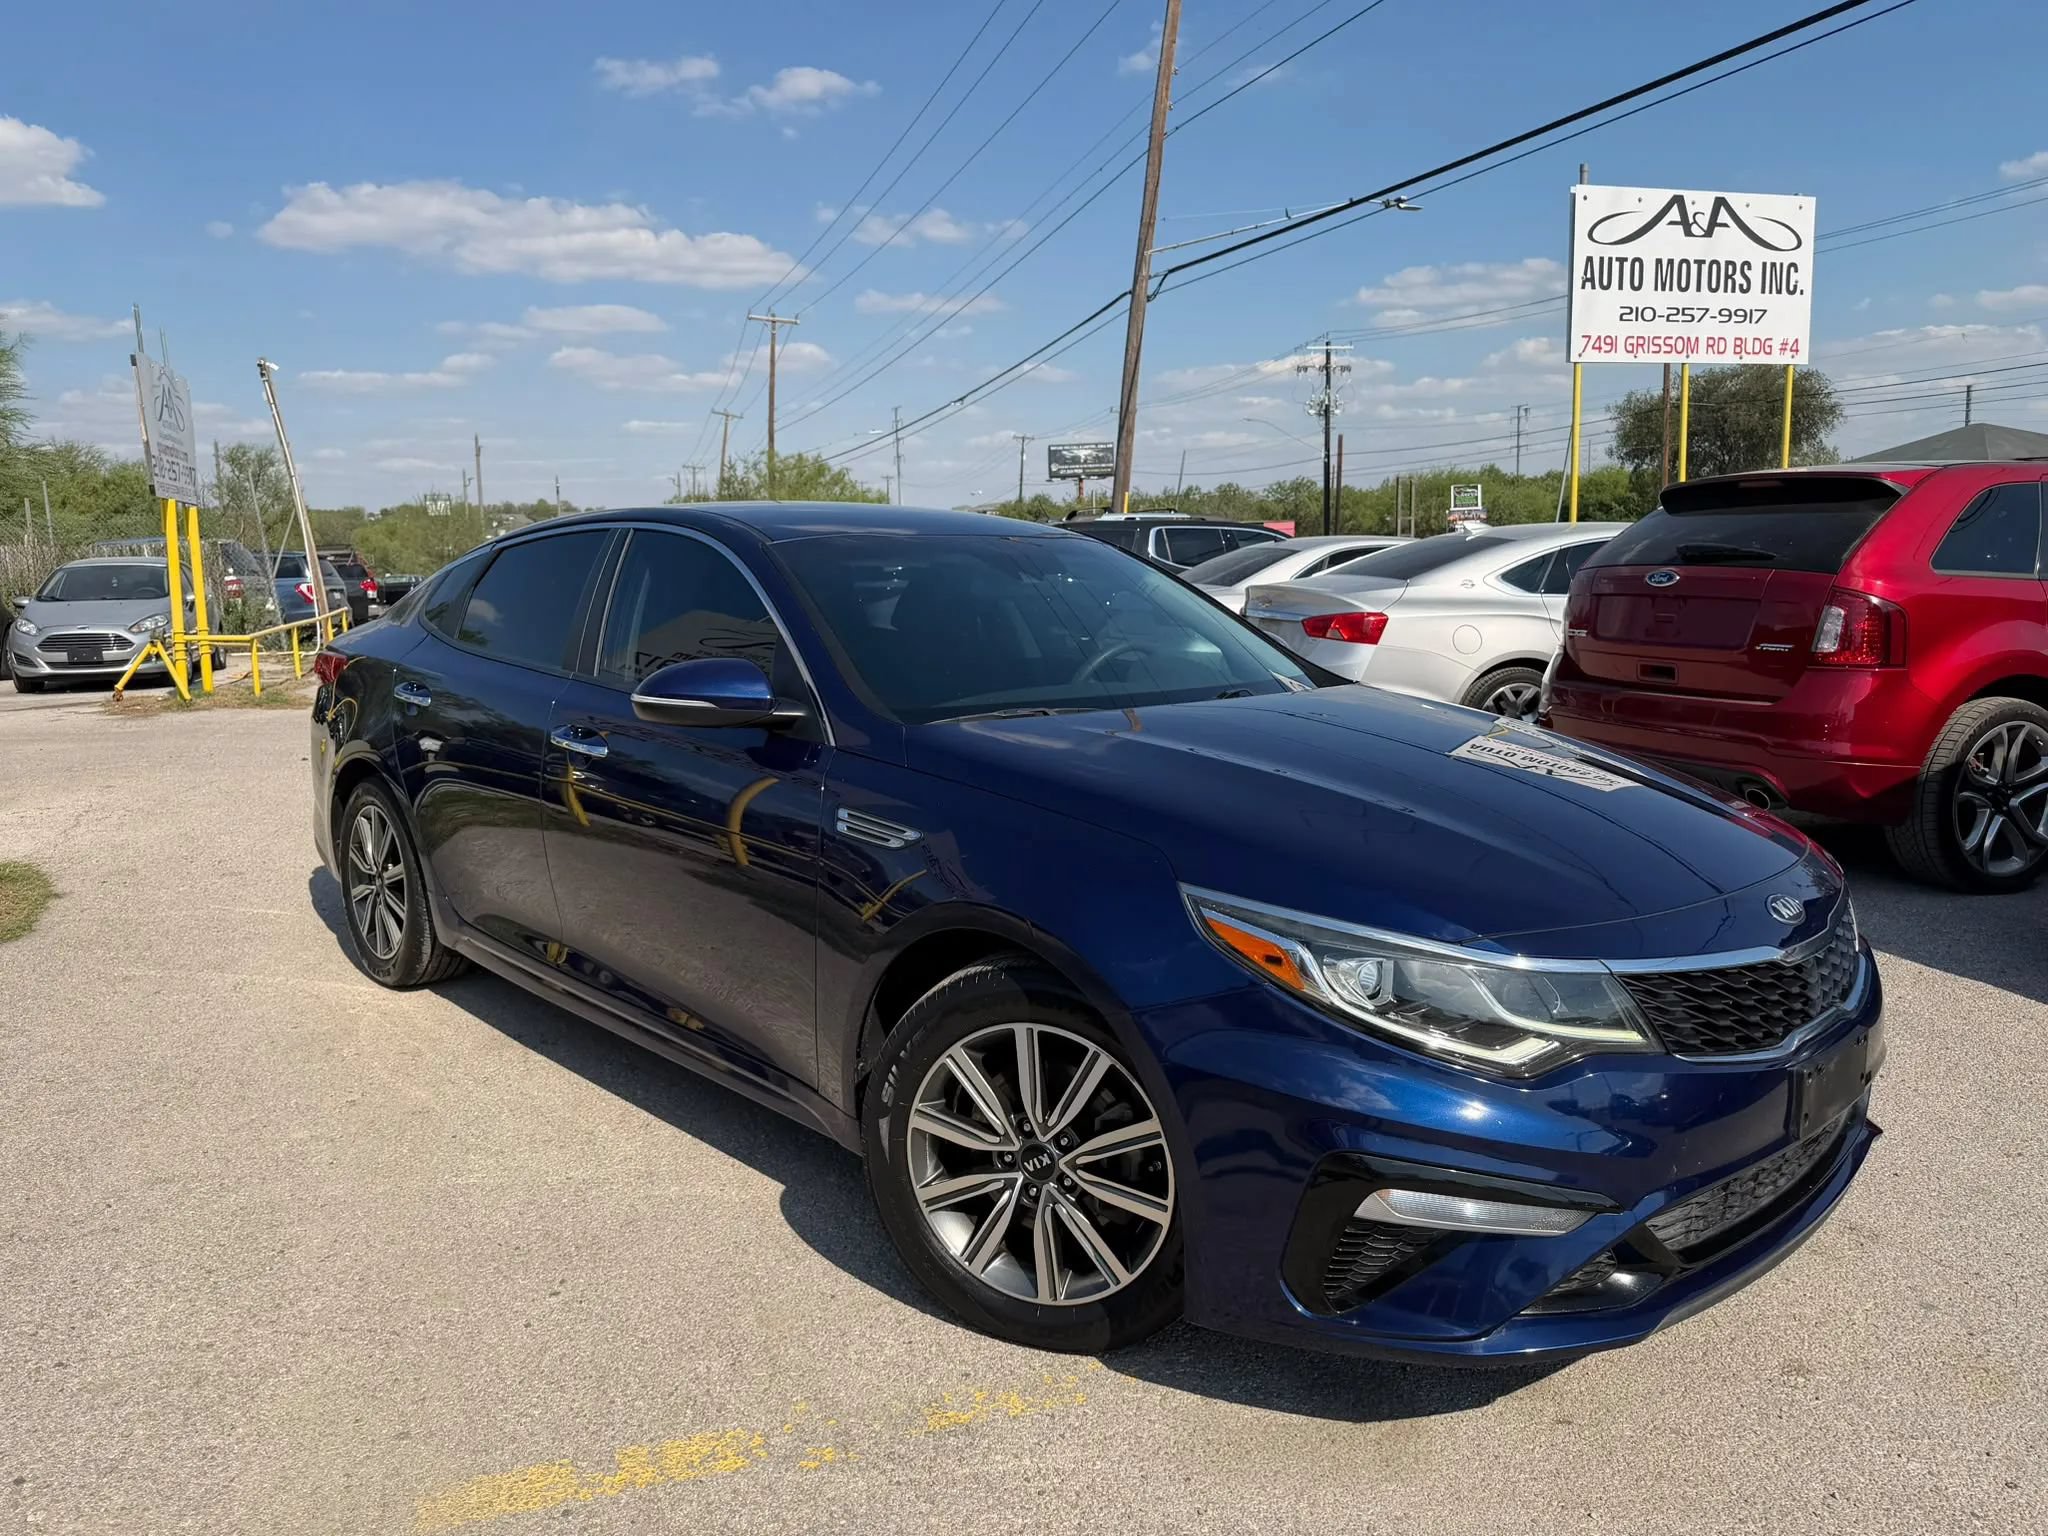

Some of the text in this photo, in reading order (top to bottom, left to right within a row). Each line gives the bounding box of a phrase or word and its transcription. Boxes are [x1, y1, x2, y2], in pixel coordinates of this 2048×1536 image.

[1587, 194, 1802, 252] A&A
[1580, 255, 1805, 296] AUTO MOTORS INC.
[1618, 305, 1768, 325] 210-257-9917
[1580, 334, 1800, 356] 7491 GRISSOM RD BLDG #4
[1023, 1153, 1052, 1172] KIA
